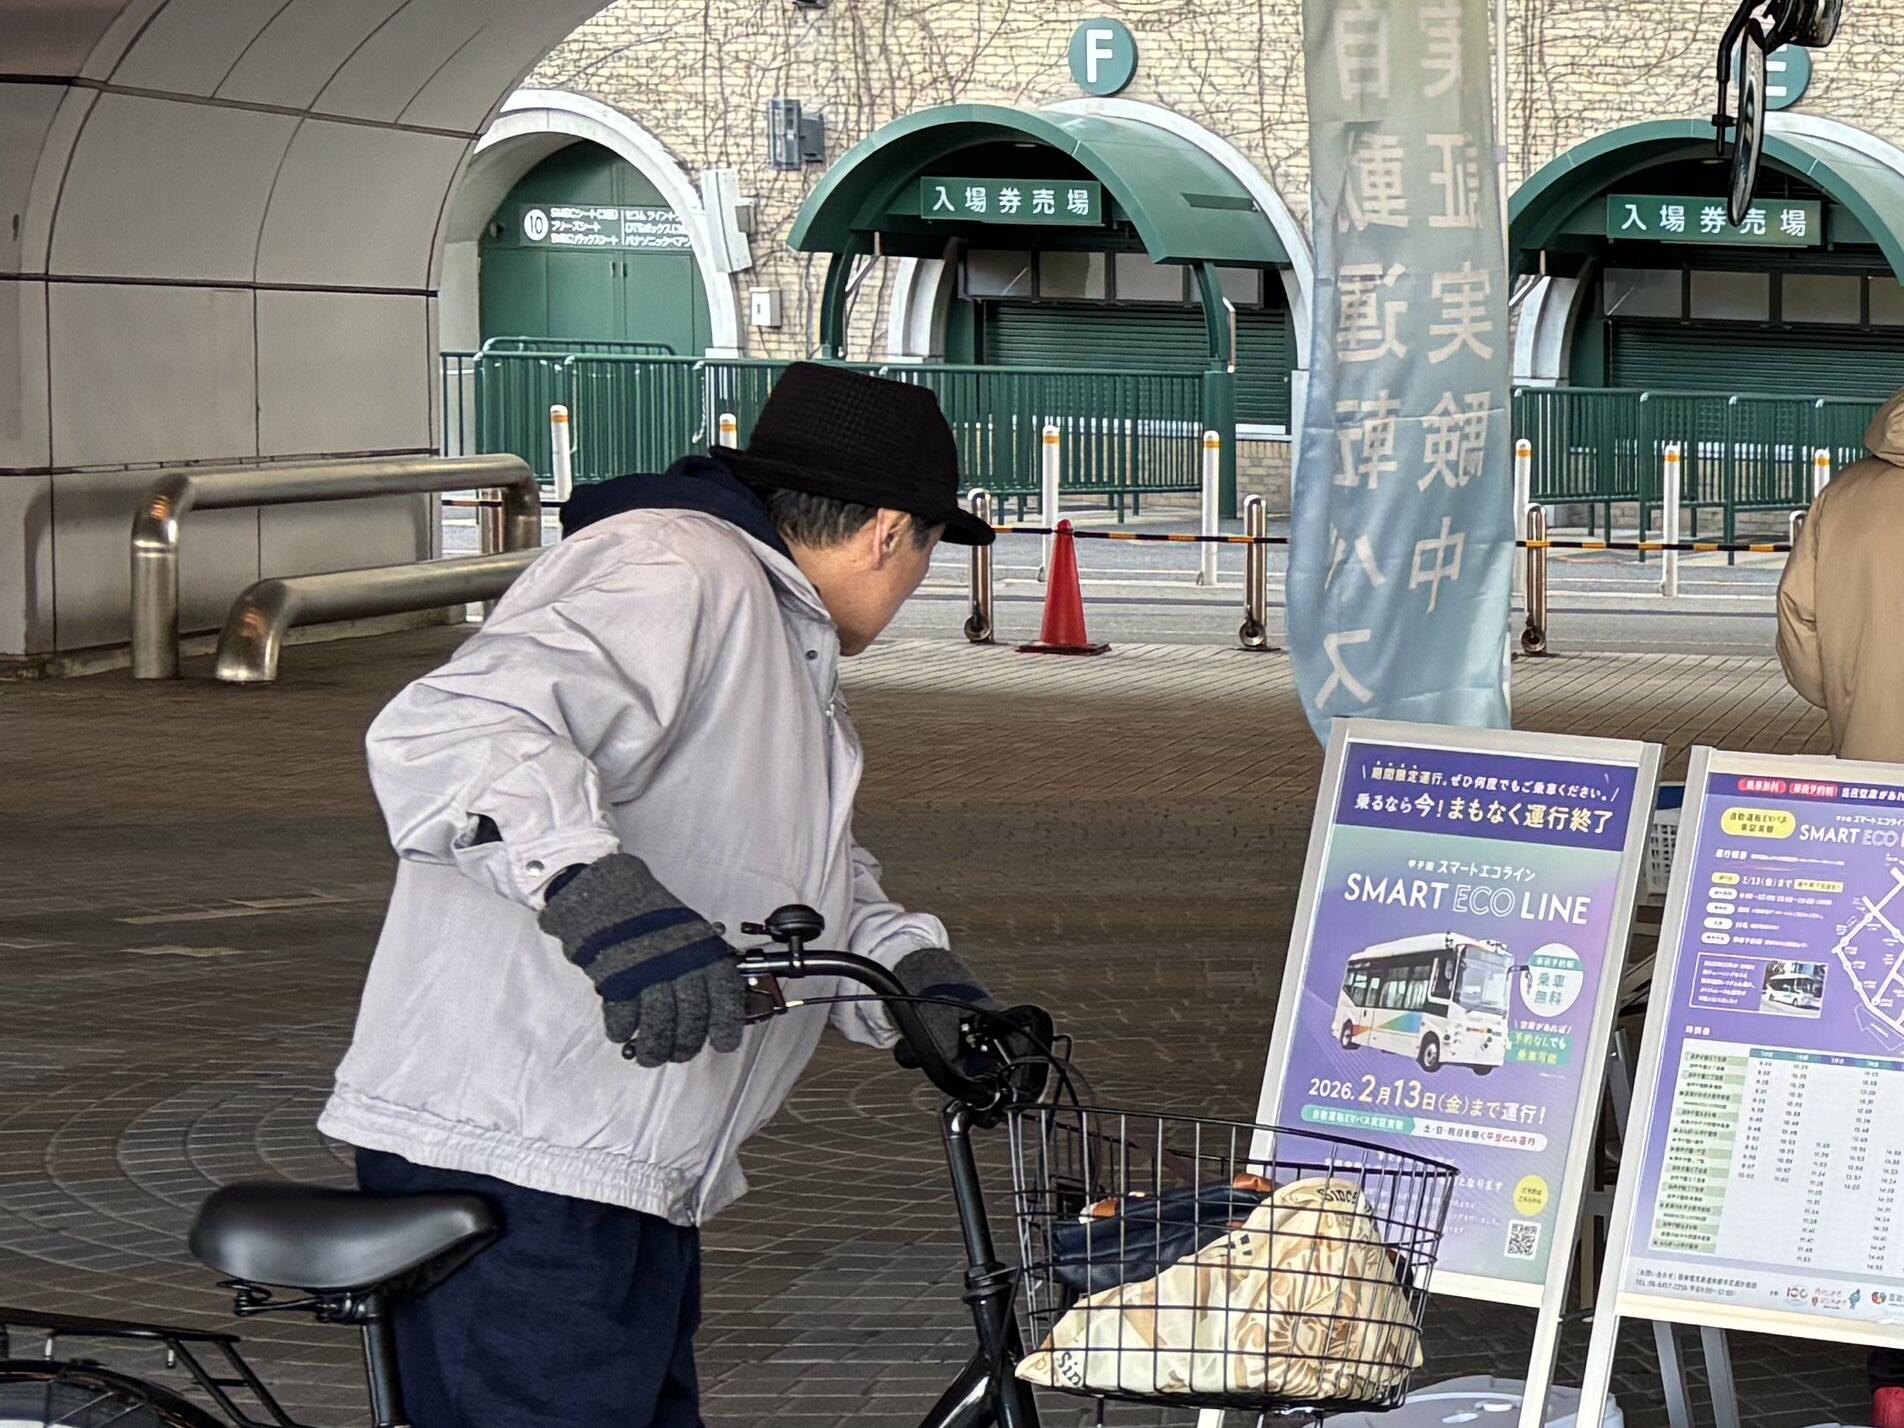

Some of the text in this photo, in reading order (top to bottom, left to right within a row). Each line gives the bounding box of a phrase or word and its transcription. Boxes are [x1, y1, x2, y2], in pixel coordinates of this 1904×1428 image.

[1086, 29, 1113, 83] F
[932, 186, 1090, 216] 入場券売場
[529, 215, 544, 234] 10
[1621, 204, 1807, 237] 入場券売場
[1799, 824, 1860, 844] SMART
[1862, 828, 1899, 848] ECO
[1437, 860, 1536, 882] スマートエコライン
[1344, 873, 1592, 925] SMART ECO LINE
